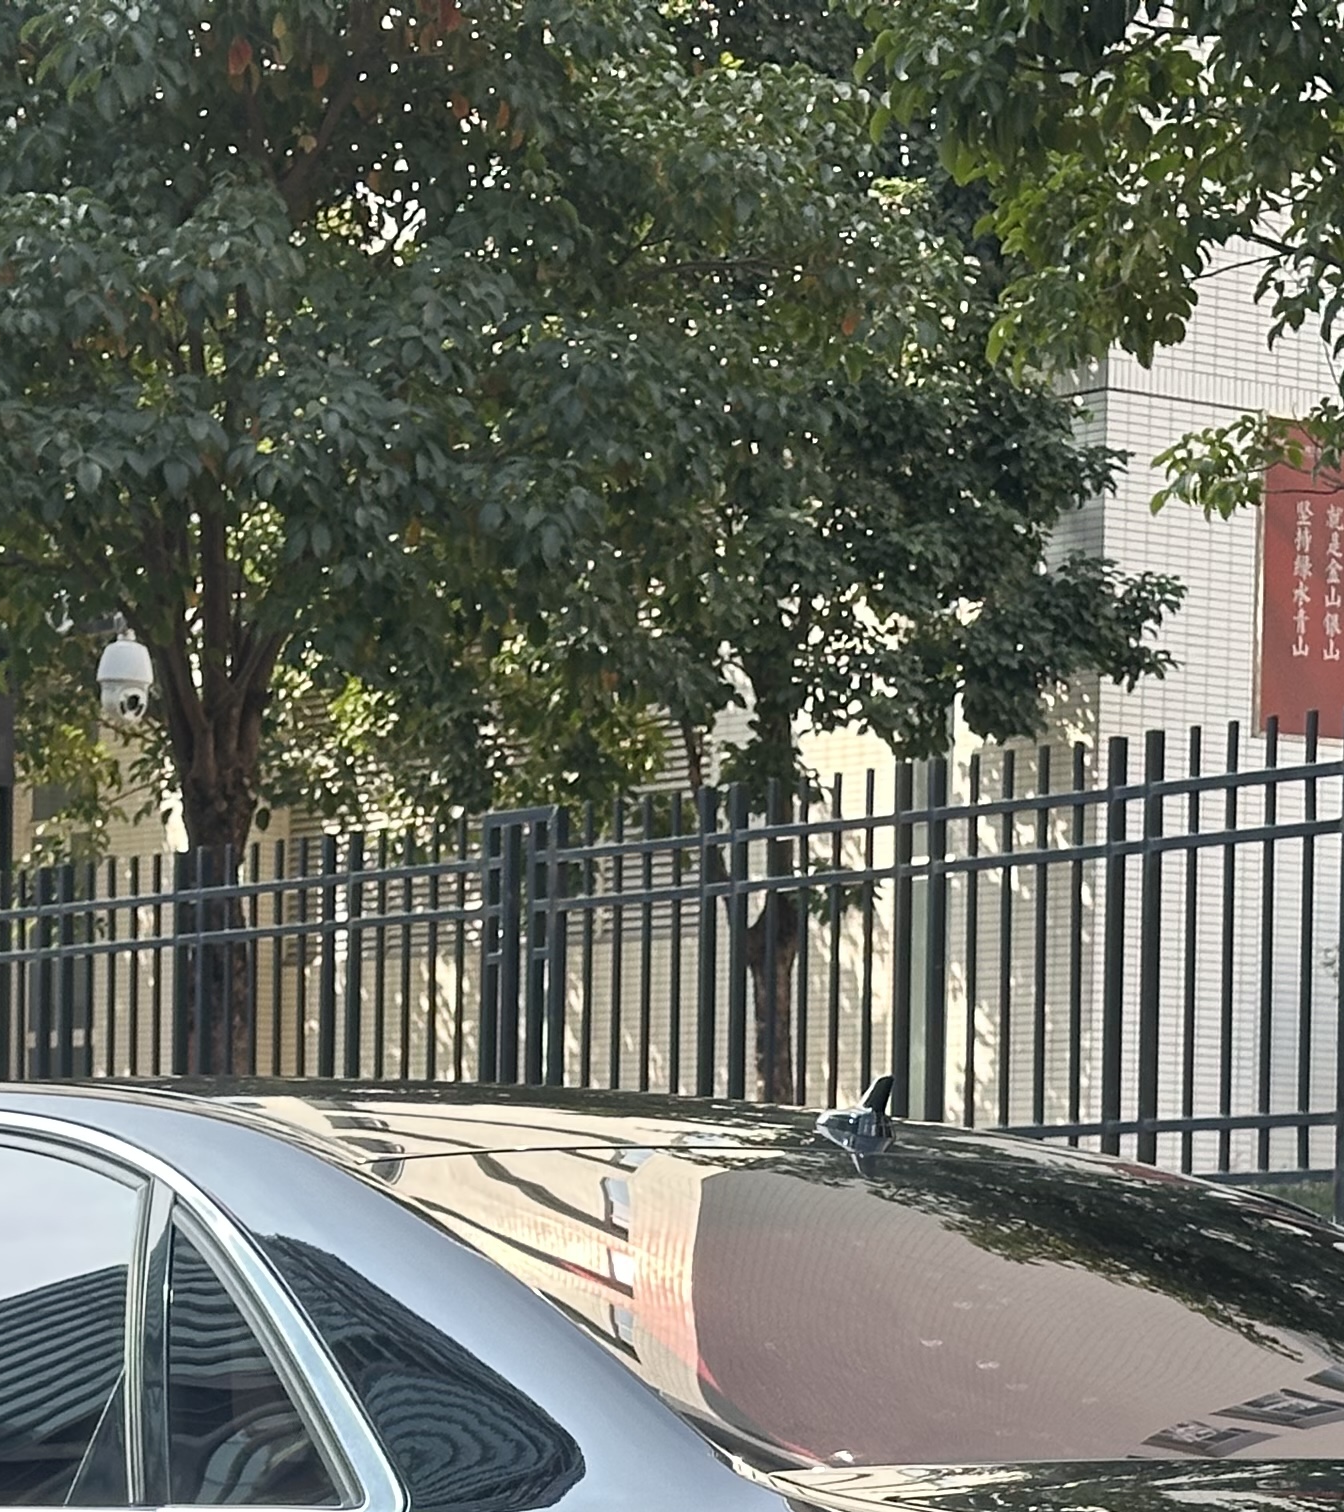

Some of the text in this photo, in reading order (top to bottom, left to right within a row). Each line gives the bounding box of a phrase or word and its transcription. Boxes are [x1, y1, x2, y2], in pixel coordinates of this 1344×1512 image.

[1323, 505, 1343, 660] 就是金山银山
